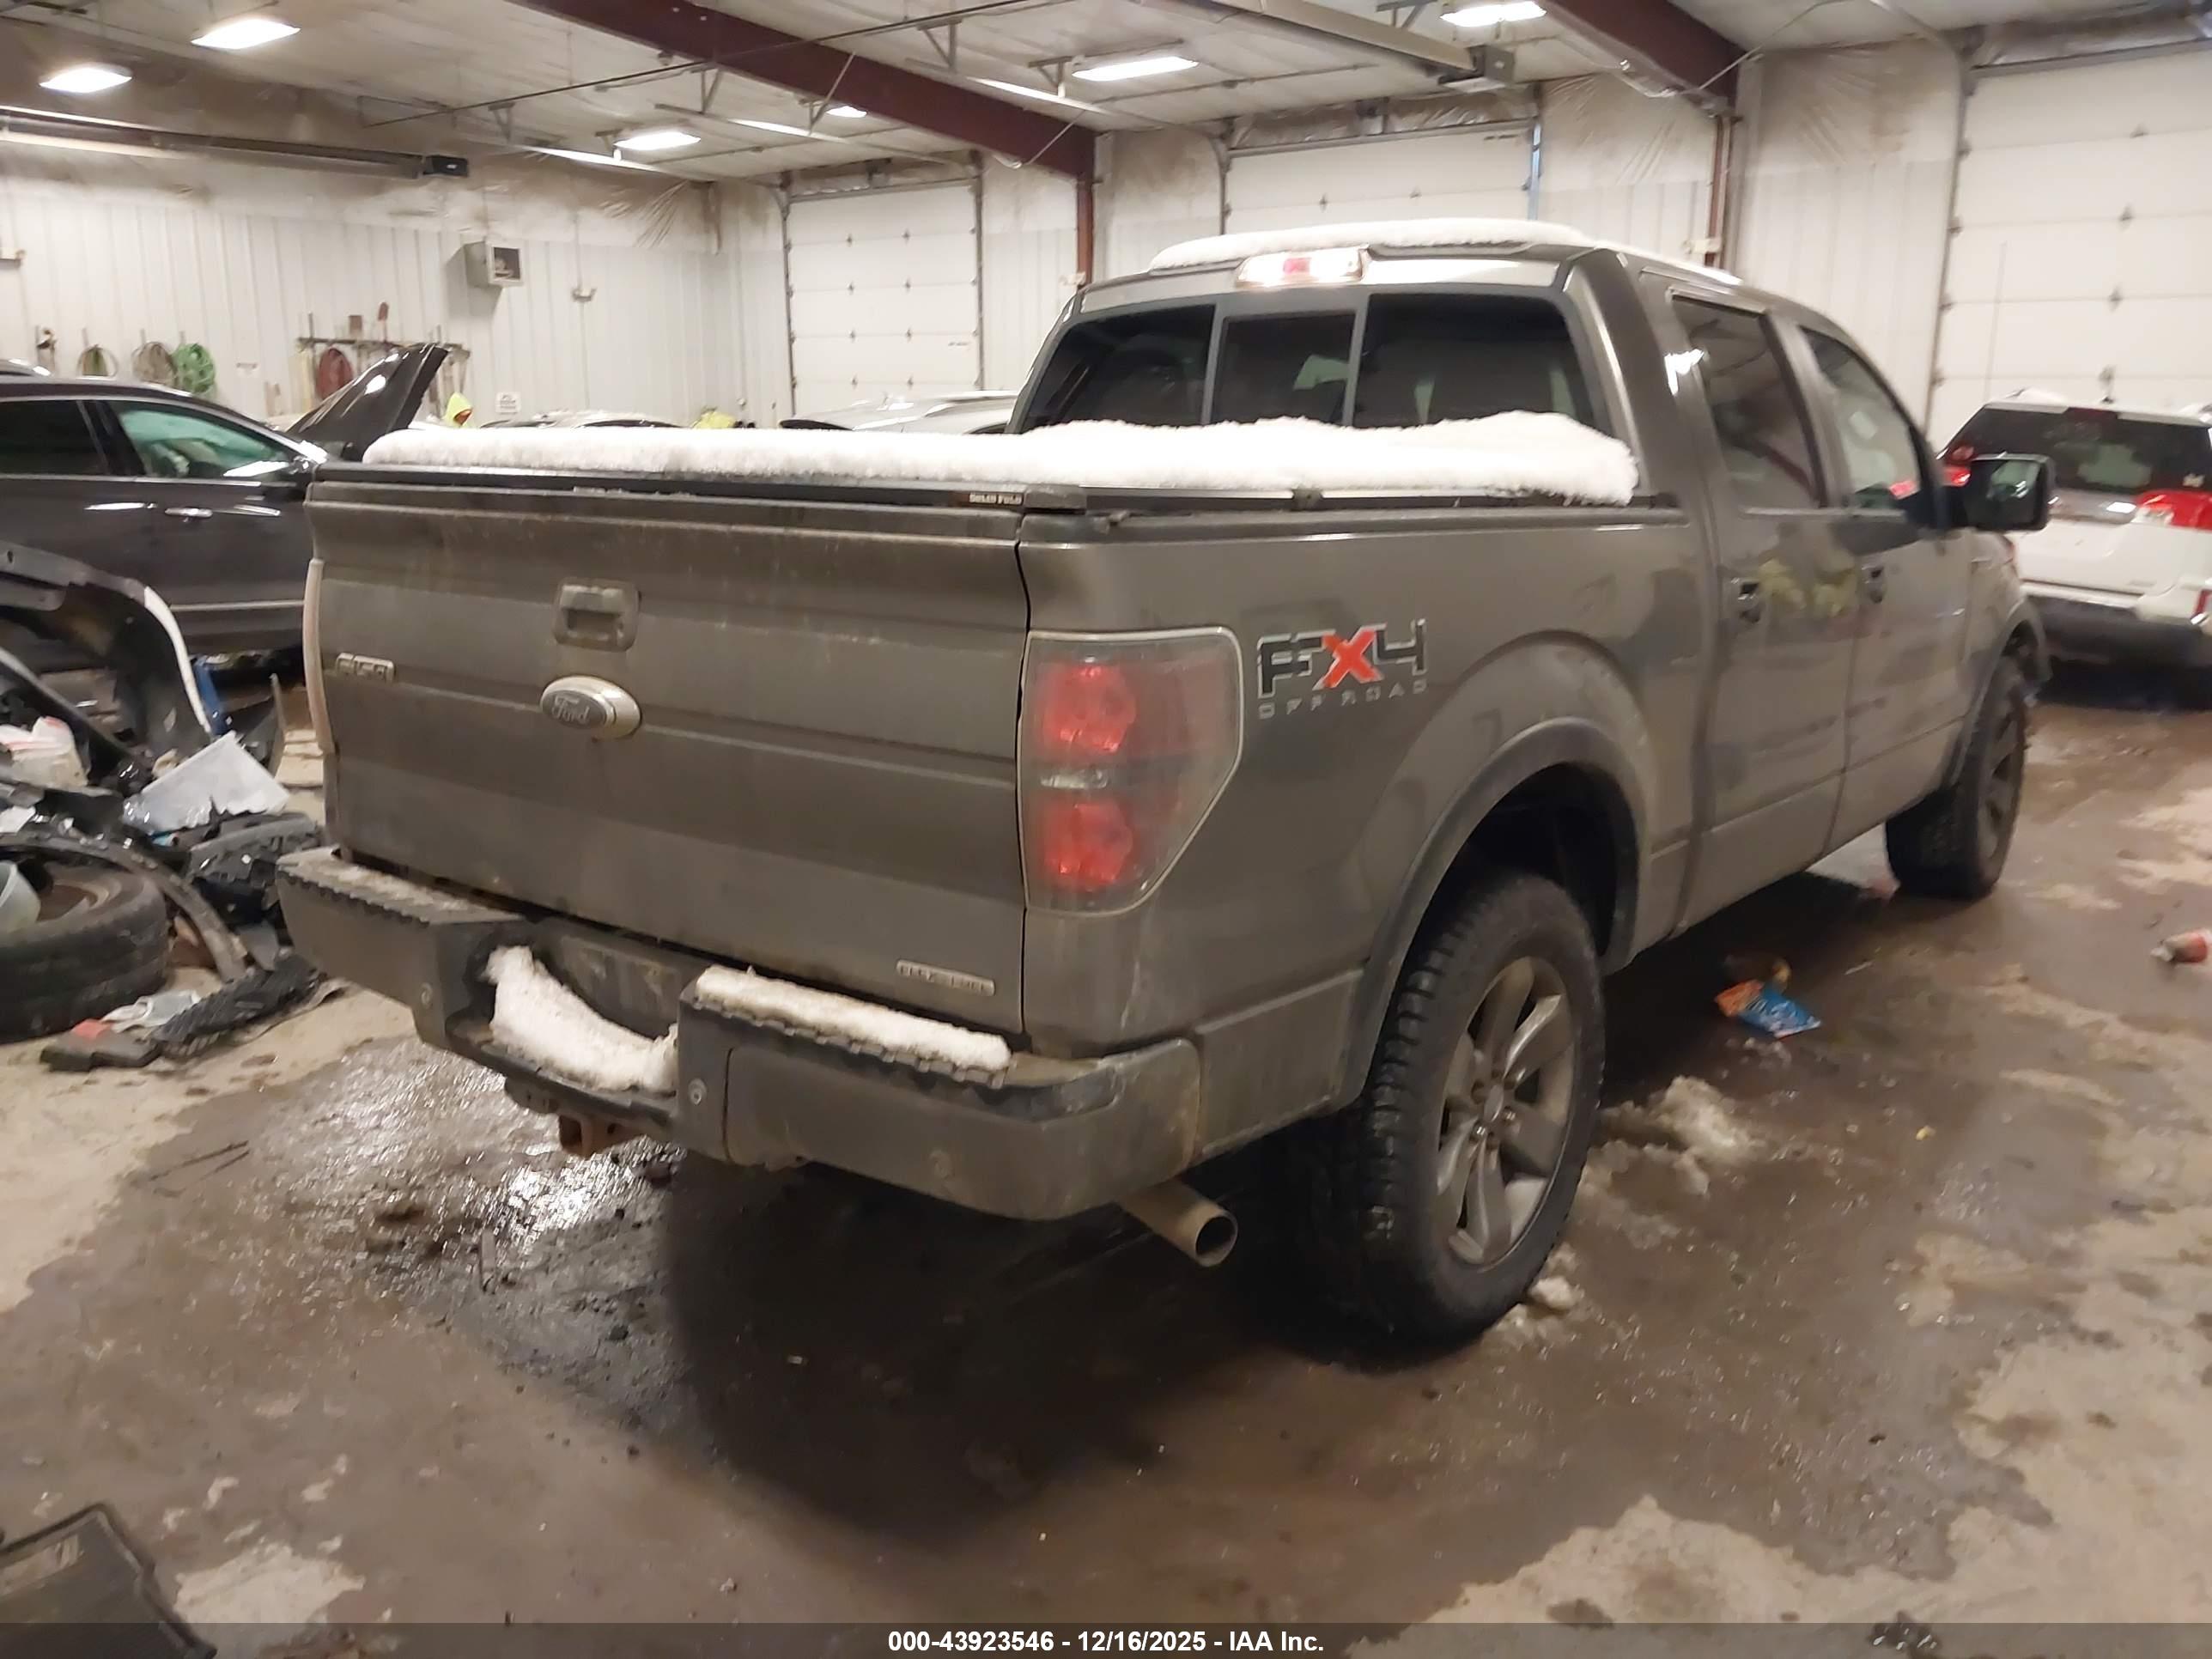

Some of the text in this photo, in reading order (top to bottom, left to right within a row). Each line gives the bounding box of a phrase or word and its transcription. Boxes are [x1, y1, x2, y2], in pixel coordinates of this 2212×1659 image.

[1257, 618, 1427, 699] FX4
[551, 694, 591, 725] Ford
[1258, 678, 1427, 720] OFF ROAD
